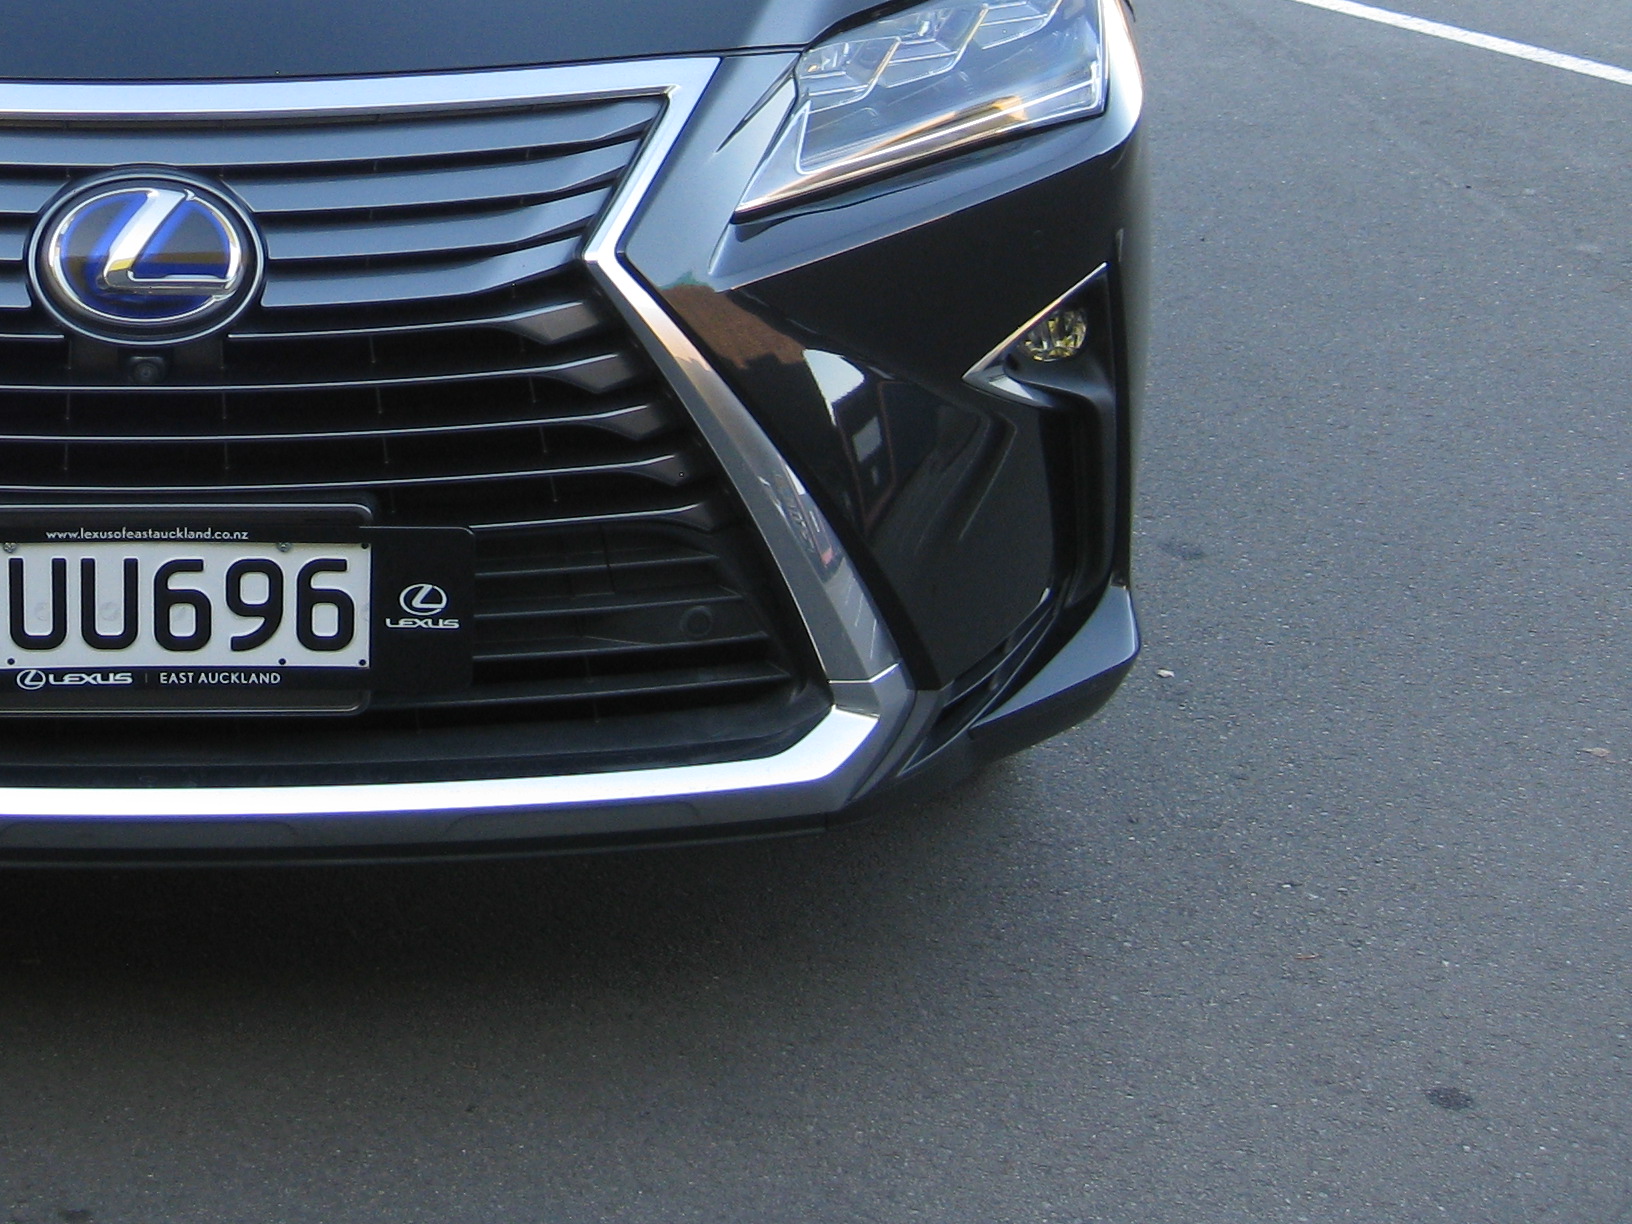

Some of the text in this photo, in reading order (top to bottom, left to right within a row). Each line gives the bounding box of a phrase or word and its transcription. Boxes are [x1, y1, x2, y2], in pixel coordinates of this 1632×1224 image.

[46, 527, 249, 540] www.lexusofeastauckland.co.nz
[385, 618, 460, 629] LEXUS
[48, 672, 281, 685] LEXUS EAST AUCKLAND
